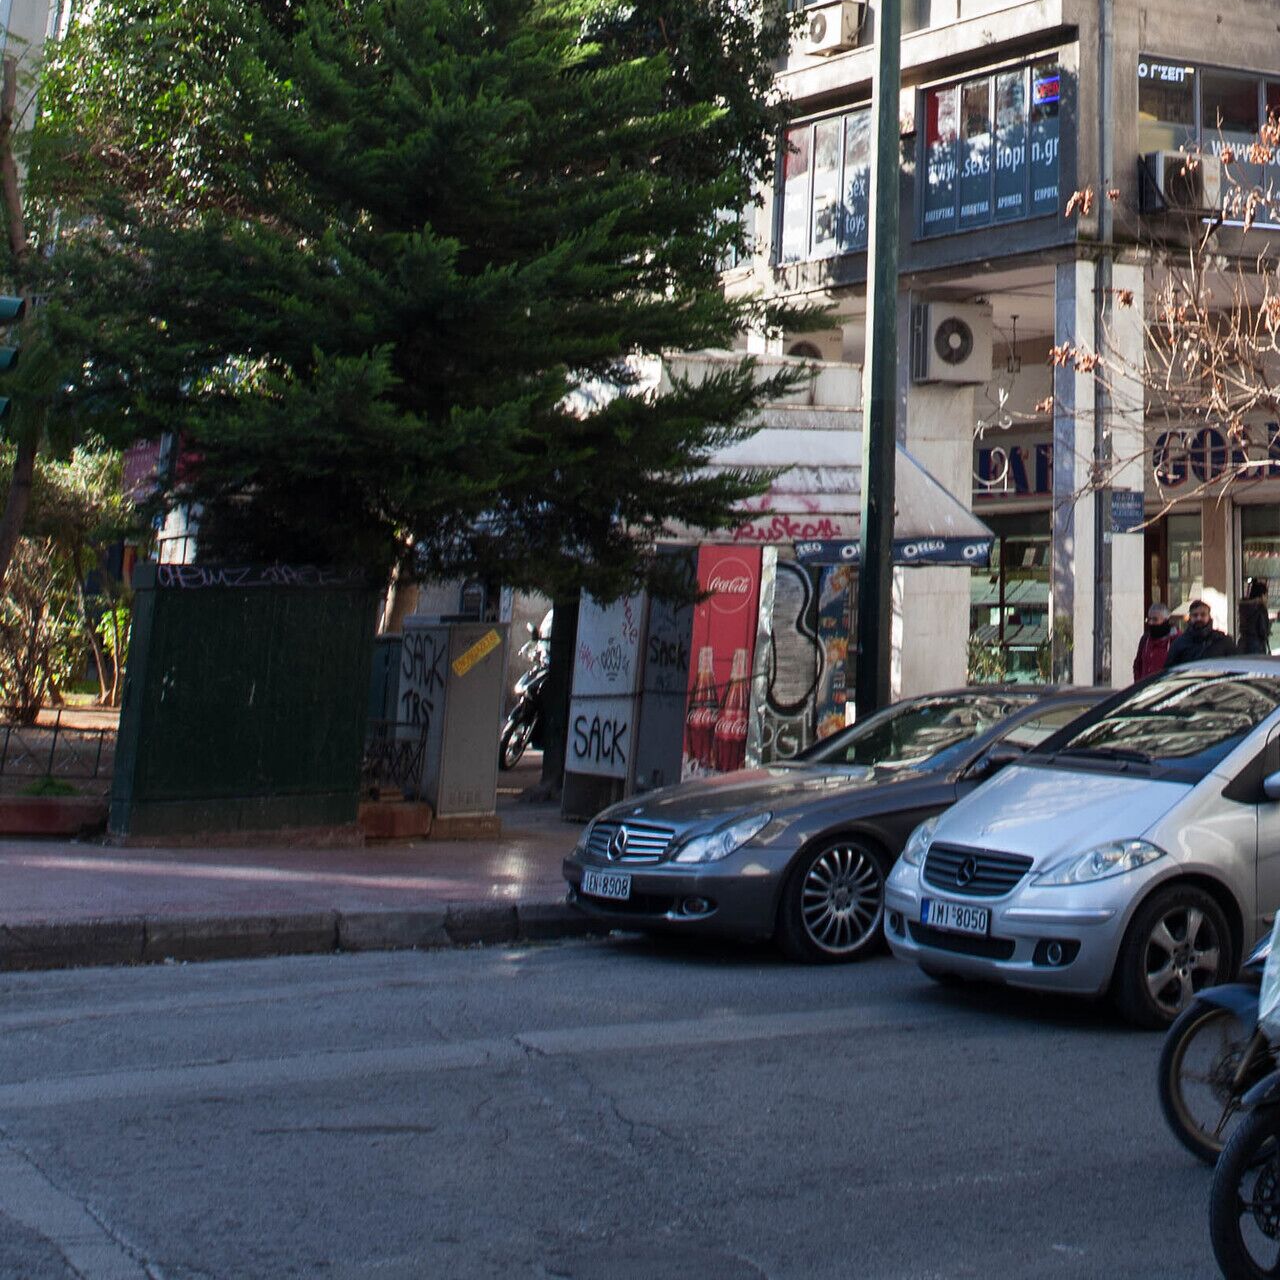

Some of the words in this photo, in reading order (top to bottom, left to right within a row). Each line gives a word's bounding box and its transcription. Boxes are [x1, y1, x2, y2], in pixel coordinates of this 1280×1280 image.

[849, 179, 866, 197] sex
[845, 214, 866, 237] toys
[402, 633, 446, 693] SACK
[650, 635, 688, 672] SACK
[574, 714, 627, 764] SACK
[956, 907, 986, 931] 8050
